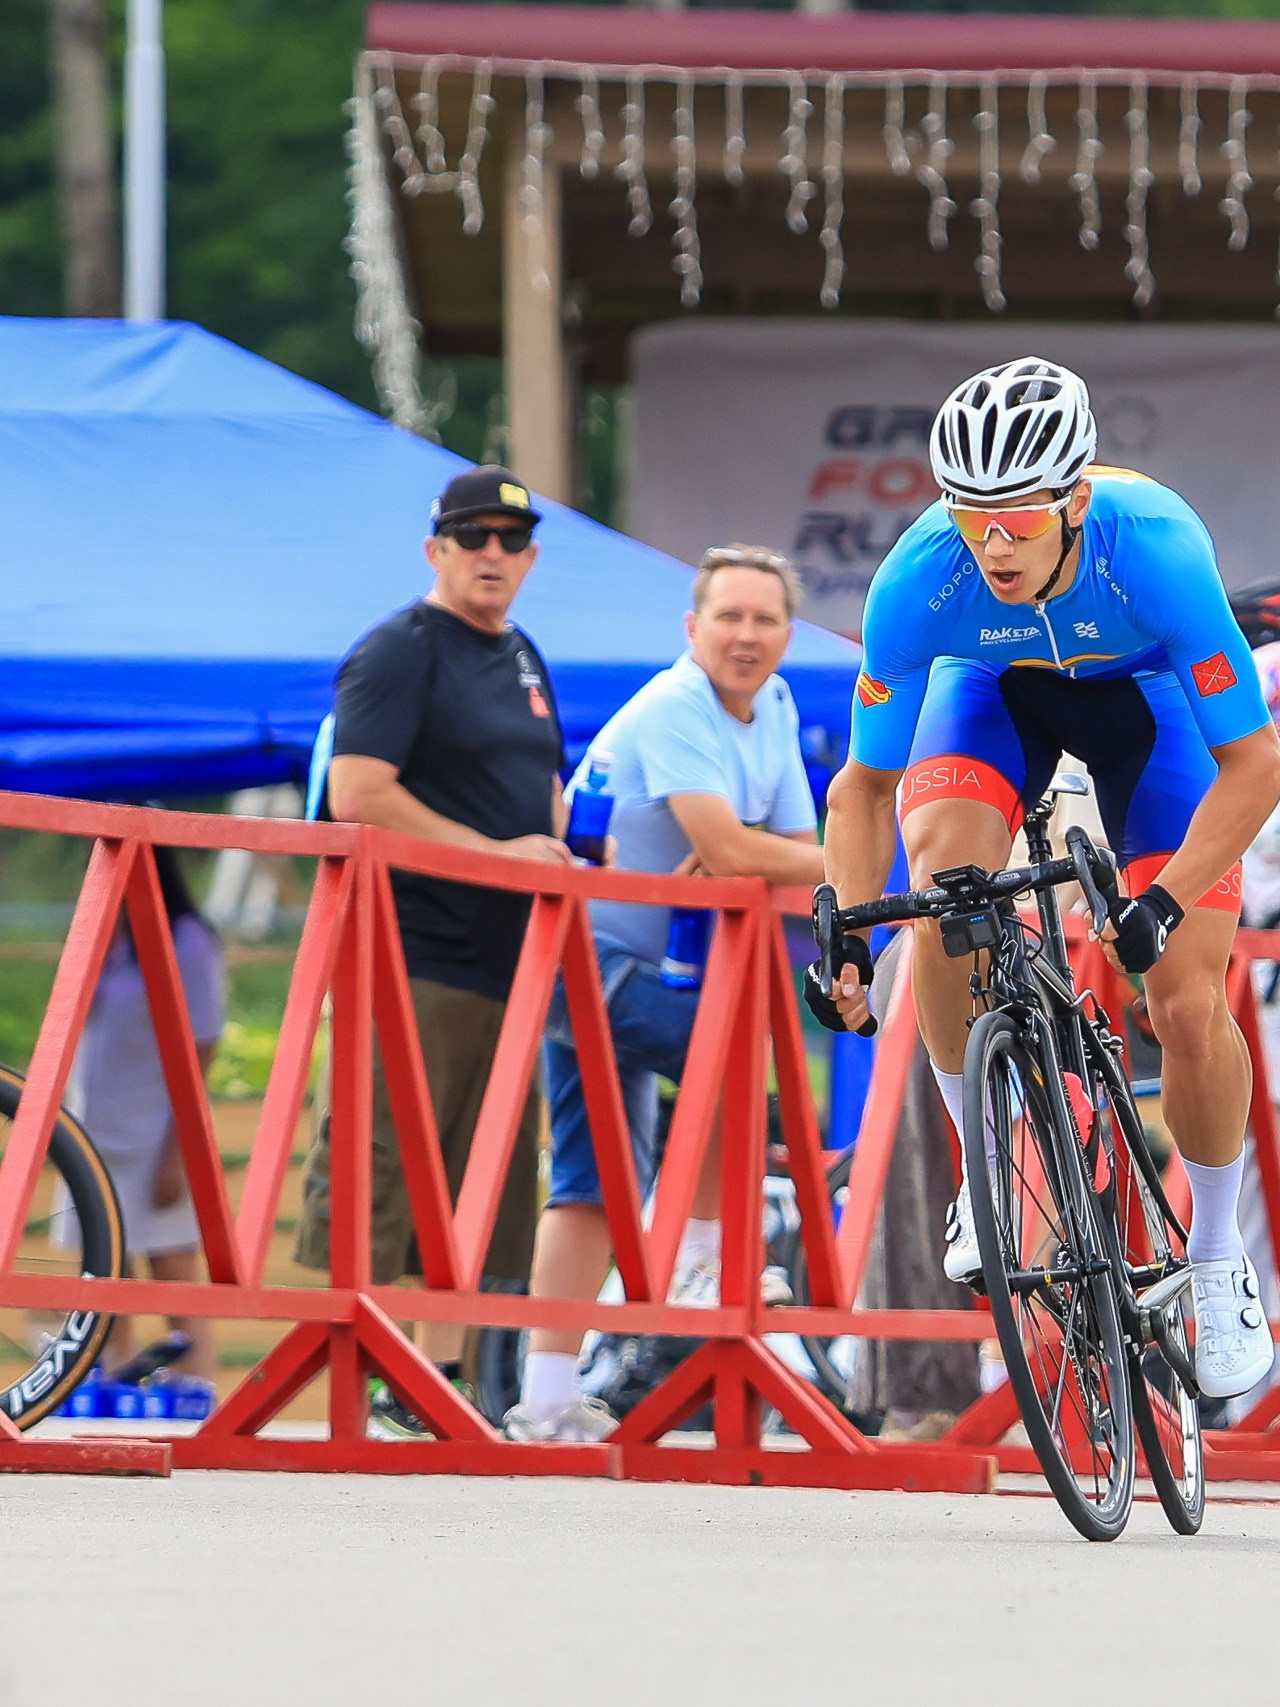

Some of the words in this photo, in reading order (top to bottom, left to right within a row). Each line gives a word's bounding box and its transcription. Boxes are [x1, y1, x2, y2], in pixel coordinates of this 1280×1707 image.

[928, 562, 975, 612] БЮРО
[980, 627, 1040, 641] RAKETA
[903, 767, 982, 804] USSIA
